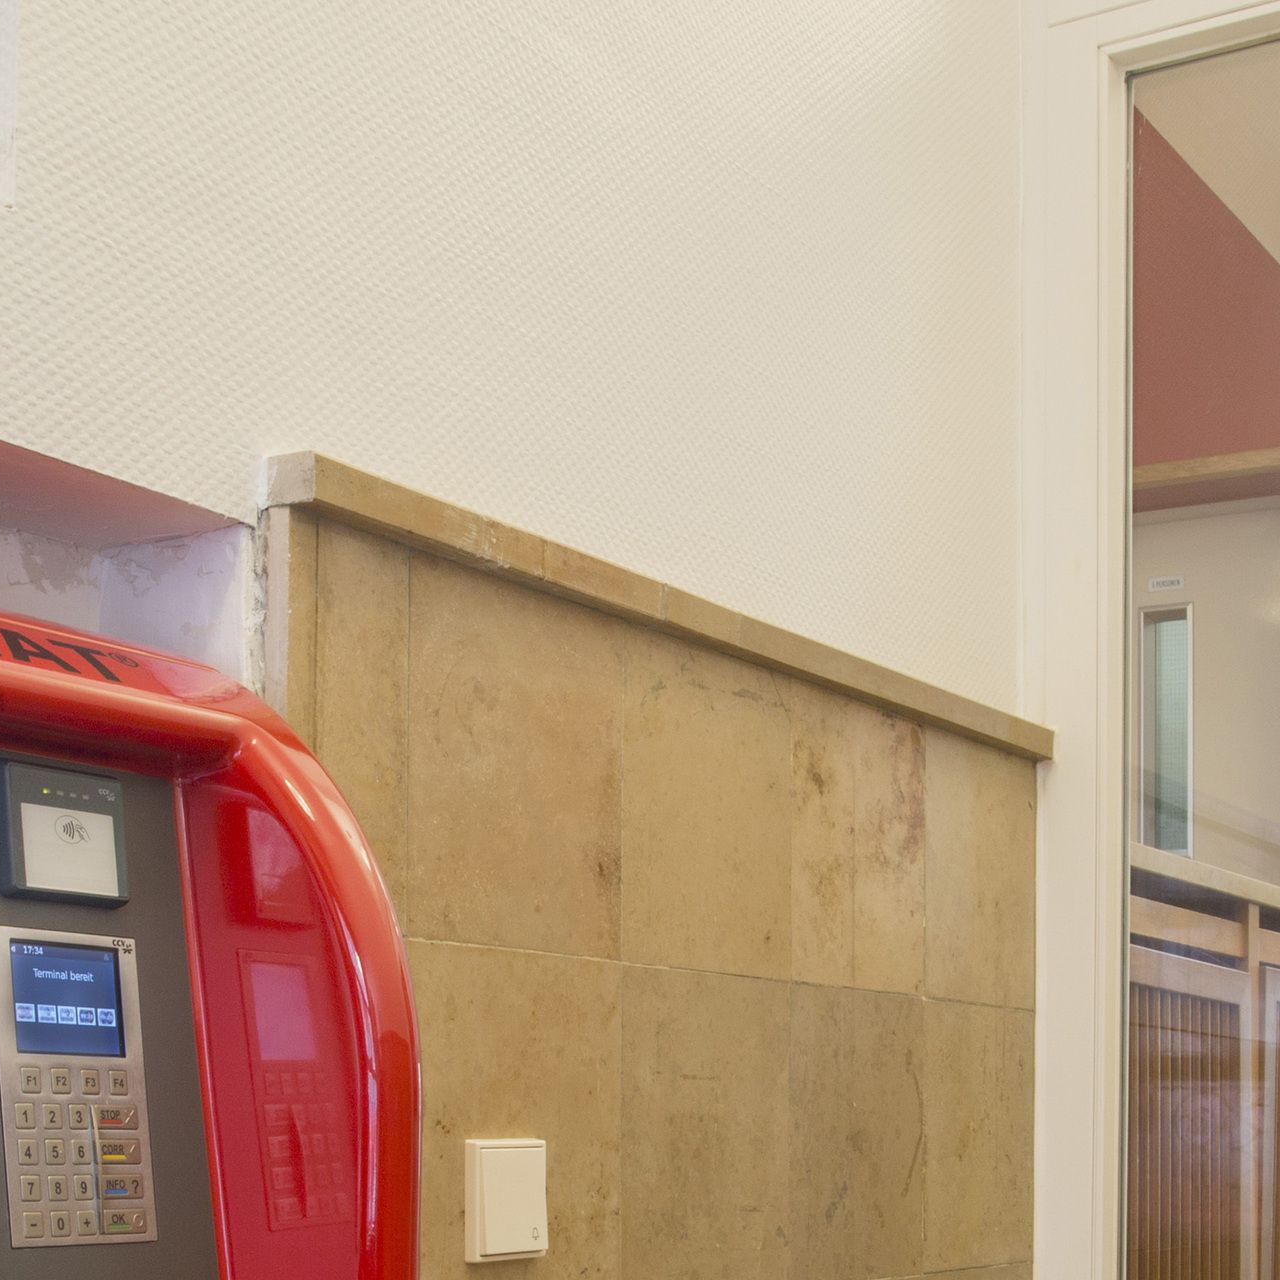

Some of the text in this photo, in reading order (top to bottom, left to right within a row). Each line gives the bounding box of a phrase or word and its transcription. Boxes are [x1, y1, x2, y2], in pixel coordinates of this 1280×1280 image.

[33, 968, 94, 982] Terminal bereit
[26, 1075, 37, 1086] F1
[56, 1076, 67, 1086] F2
[85, 1077, 96, 1088] F3
[113, 1078, 124, 1089] F4
[23, 1111, 29, 1123] 1
[49, 1111, 56, 1124] 2
[75, 1111, 82, 1124] 3
[100, 1110, 121, 1120] STOP
[24, 1146, 32, 1159] 4
[52, 1146, 59, 1159] 5
[78, 1146, 85, 1158] 6
[27, 1182, 34, 1195] 7
[55, 1182, 62, 1195] 8
[80, 1181, 87, 1194] 9
[106, 1179, 139, 1194] INFO ?
[57, 1217, 65, 1230] 0
[111, 1214, 126, 1224] OK
